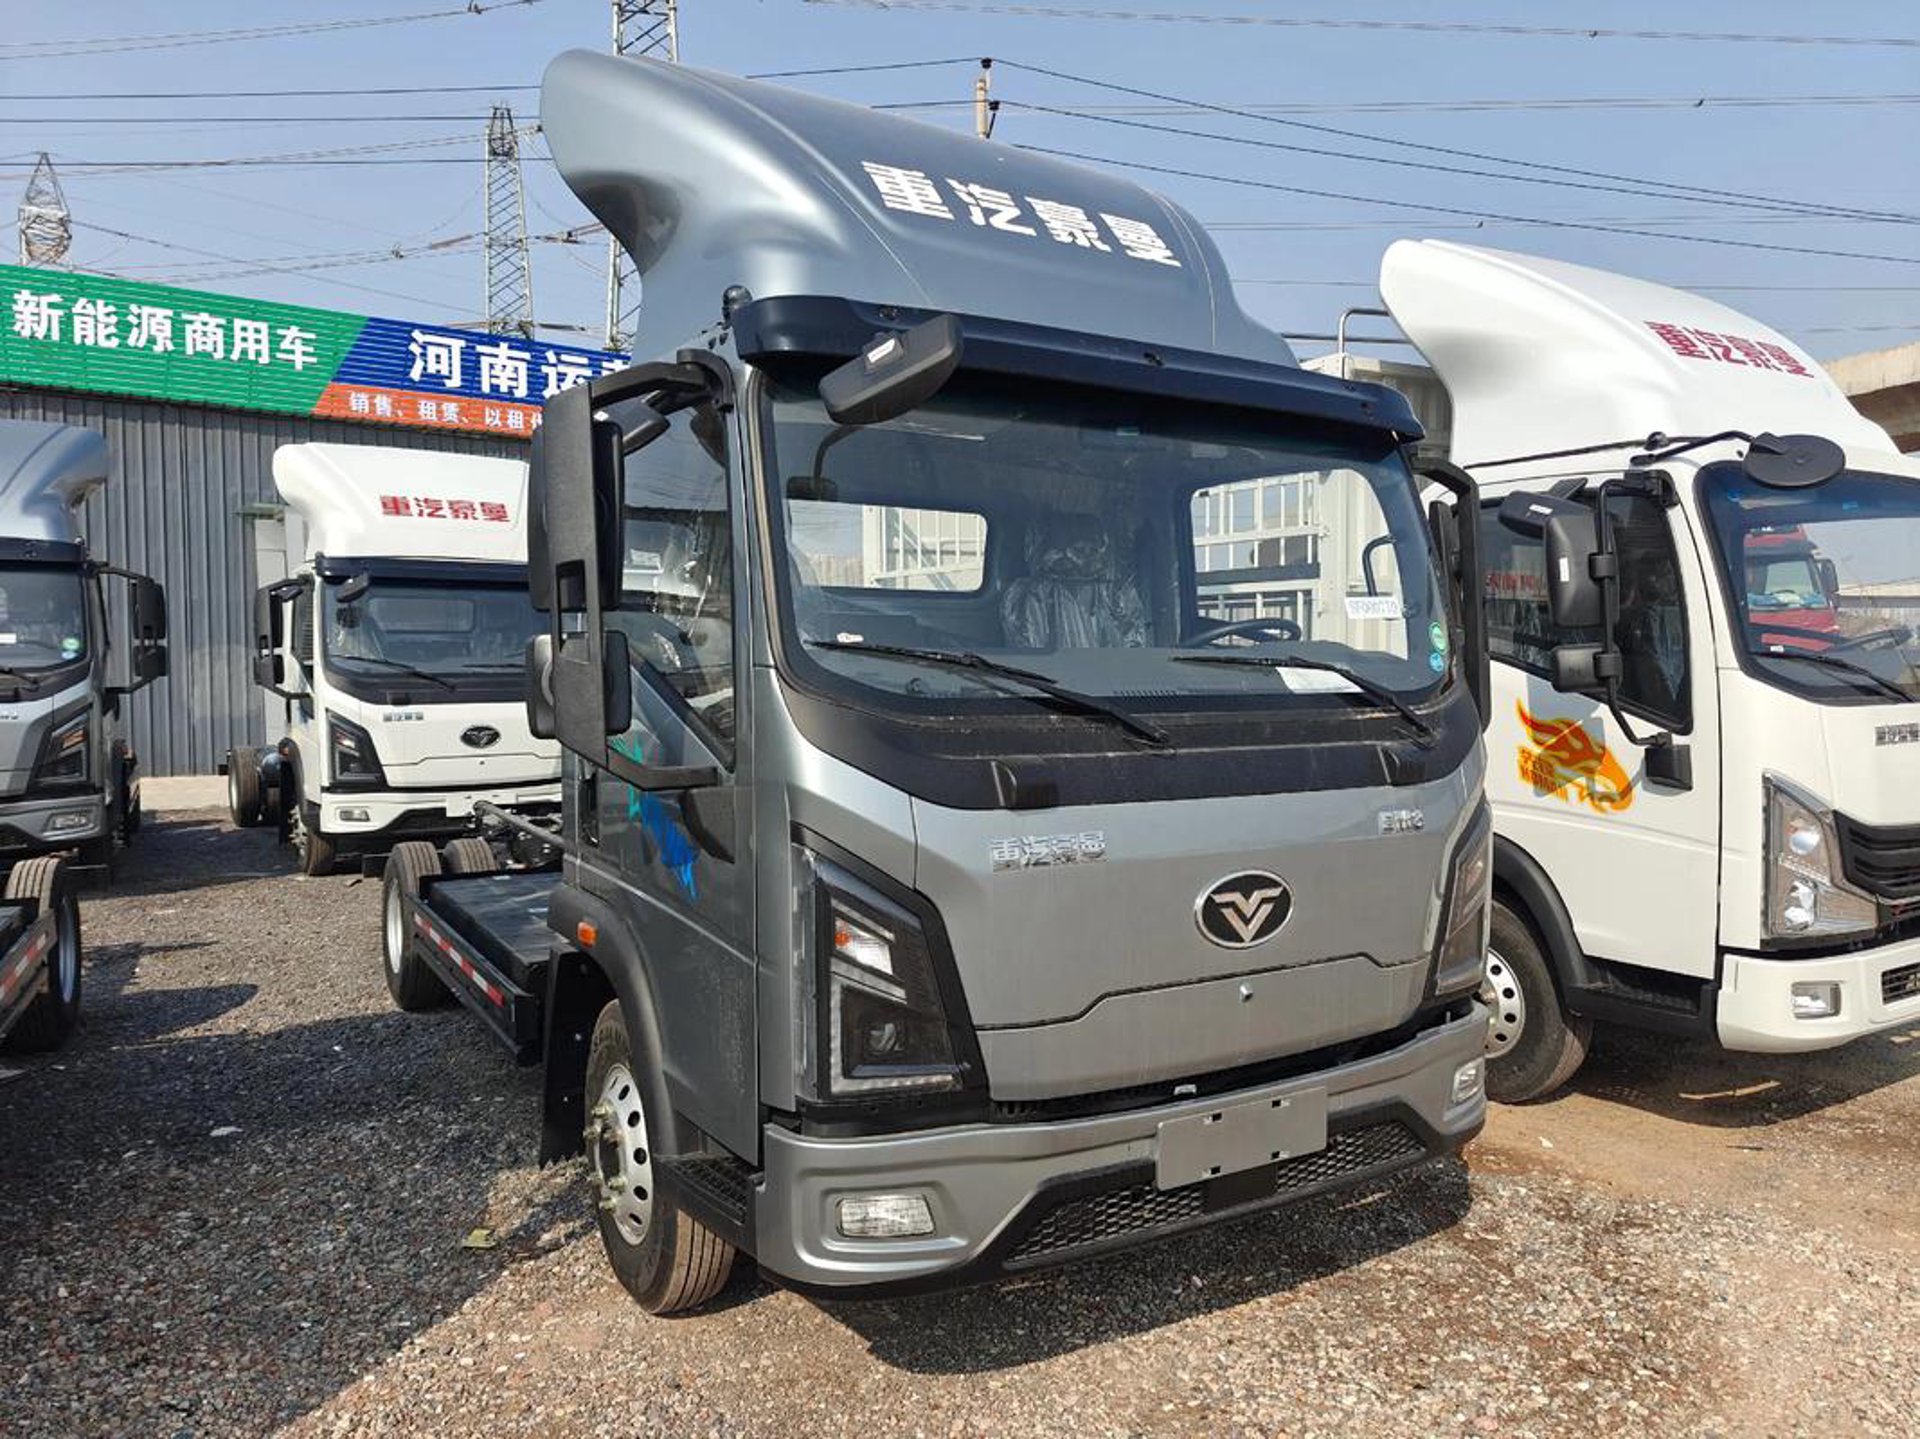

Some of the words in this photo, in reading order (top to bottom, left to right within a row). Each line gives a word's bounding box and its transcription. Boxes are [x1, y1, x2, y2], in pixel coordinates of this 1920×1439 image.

[861, 160, 1182, 268] 重汽豪曼
[12, 289, 318, 371] 新能源商用车
[1643, 320, 1815, 379] 重汽豪曼
[379, 495, 511, 523] 重汽豪曼
